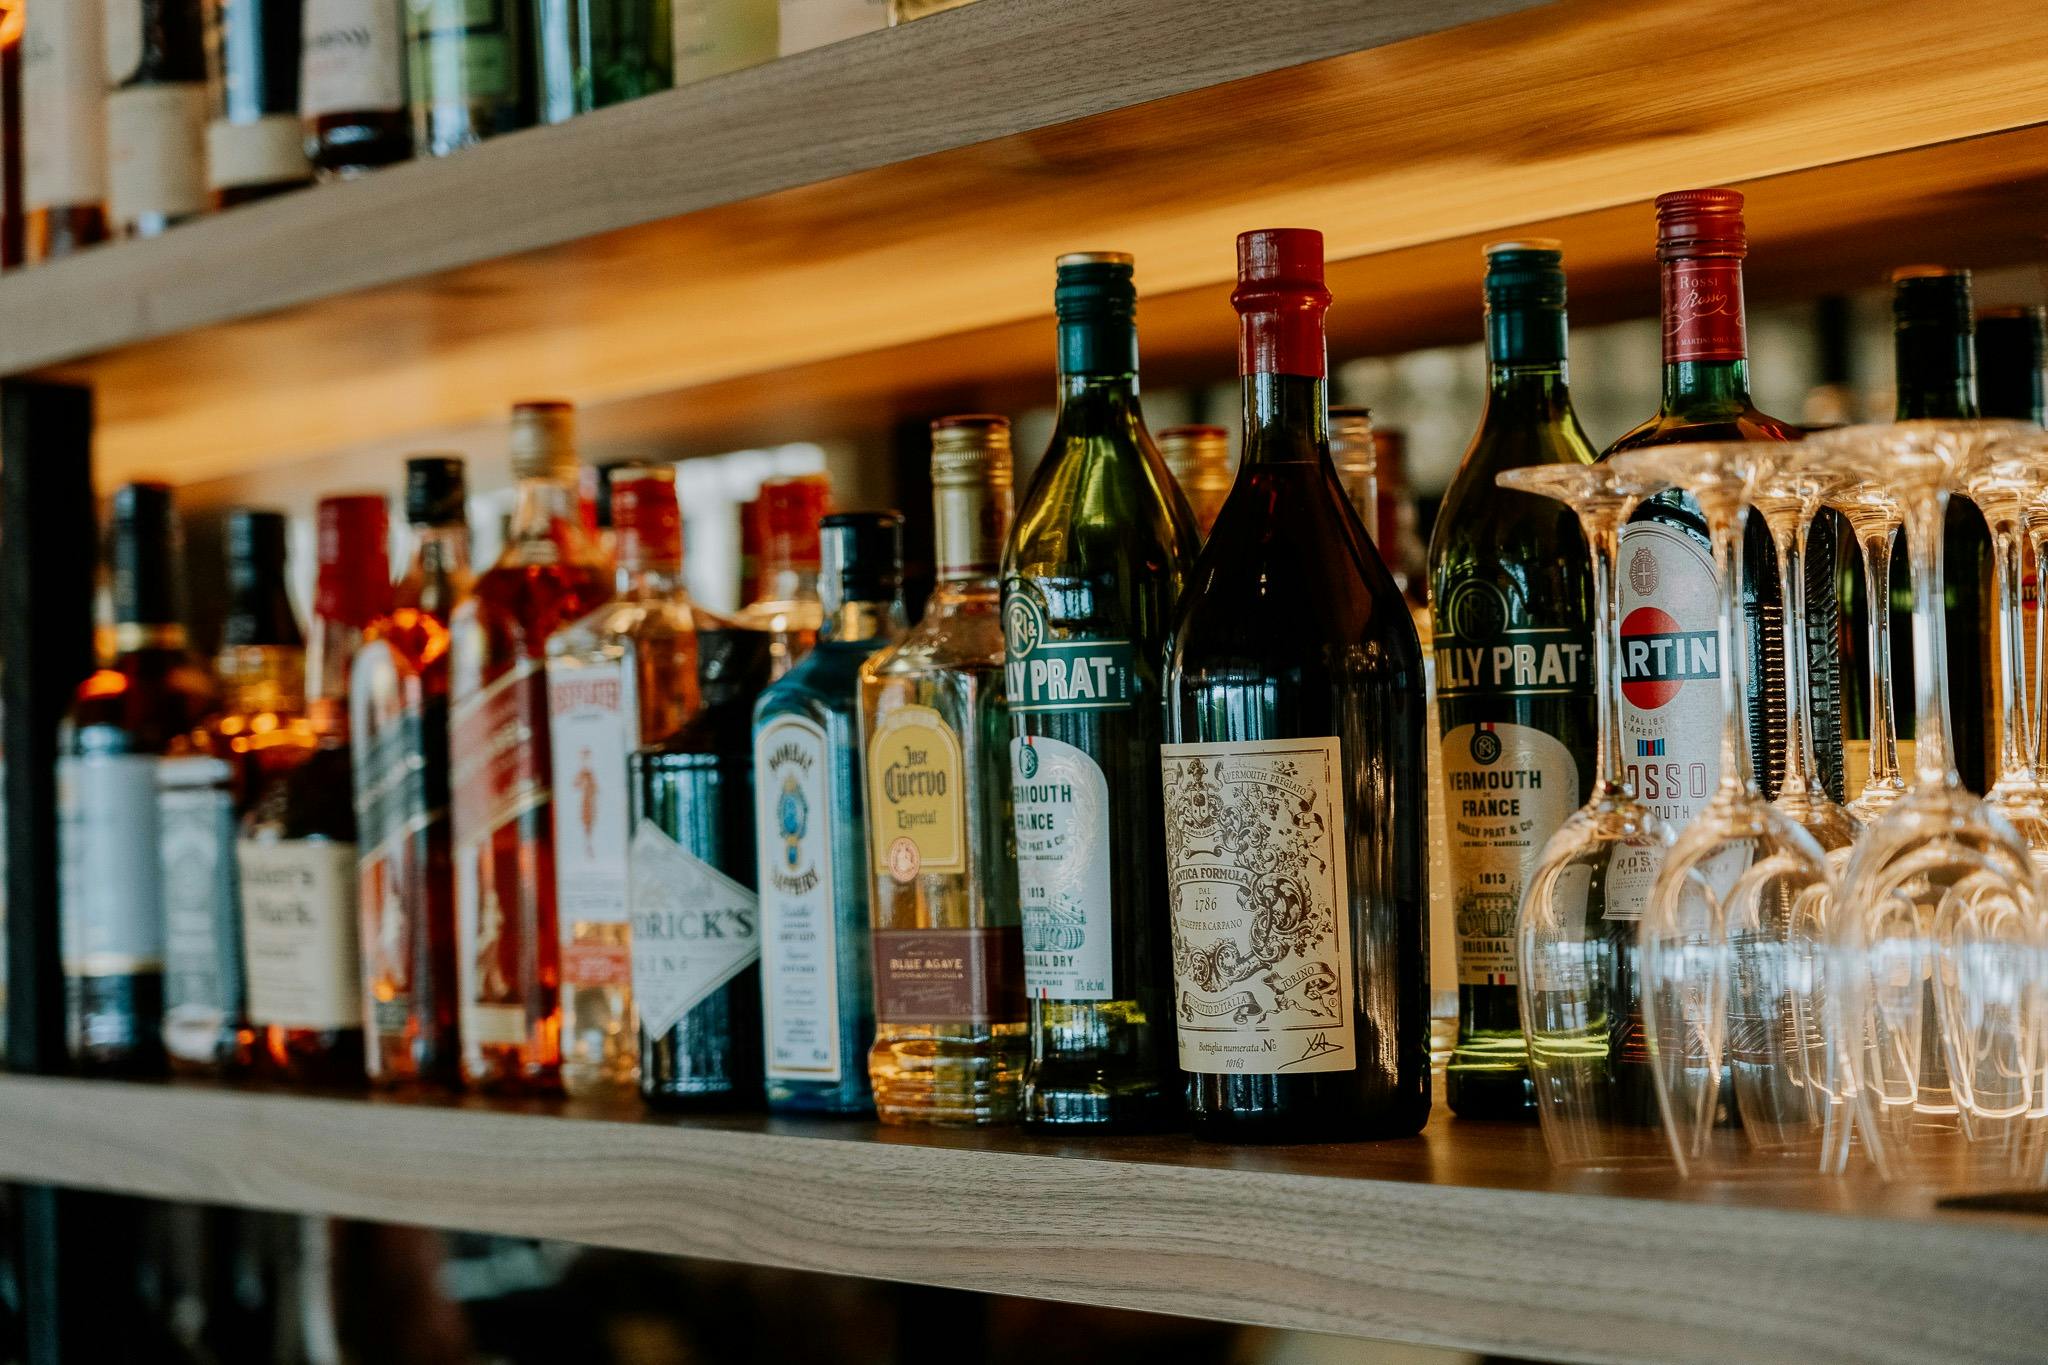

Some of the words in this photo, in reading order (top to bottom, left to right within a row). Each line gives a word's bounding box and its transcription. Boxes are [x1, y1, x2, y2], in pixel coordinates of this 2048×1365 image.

[1493, 643, 1582, 686] PRAT
[1029, 657, 1113, 701] PRAT
[884, 761, 948, 805] Cuervo
[1226, 769, 1268, 781] VERMOUTH
[1270, 773, 1308, 796] PREGIATO
[1448, 770, 1542, 791] VERMOUTH
[1462, 799, 1520, 817] FRANCE
[1654, 805, 1690, 820] OUTH
[1483, 826, 1506, 838] PRAT
[1201, 867, 1249, 885] FORMULA
[1478, 872, 1507, 885] 1813
[1195, 896, 1218, 912] 1786
[889, 958, 922, 970] BLUE
[924, 958, 963, 970] AGAVE
[1053, 955, 1074, 967] DRY
[1282, 966, 1315, 990] TORINO
